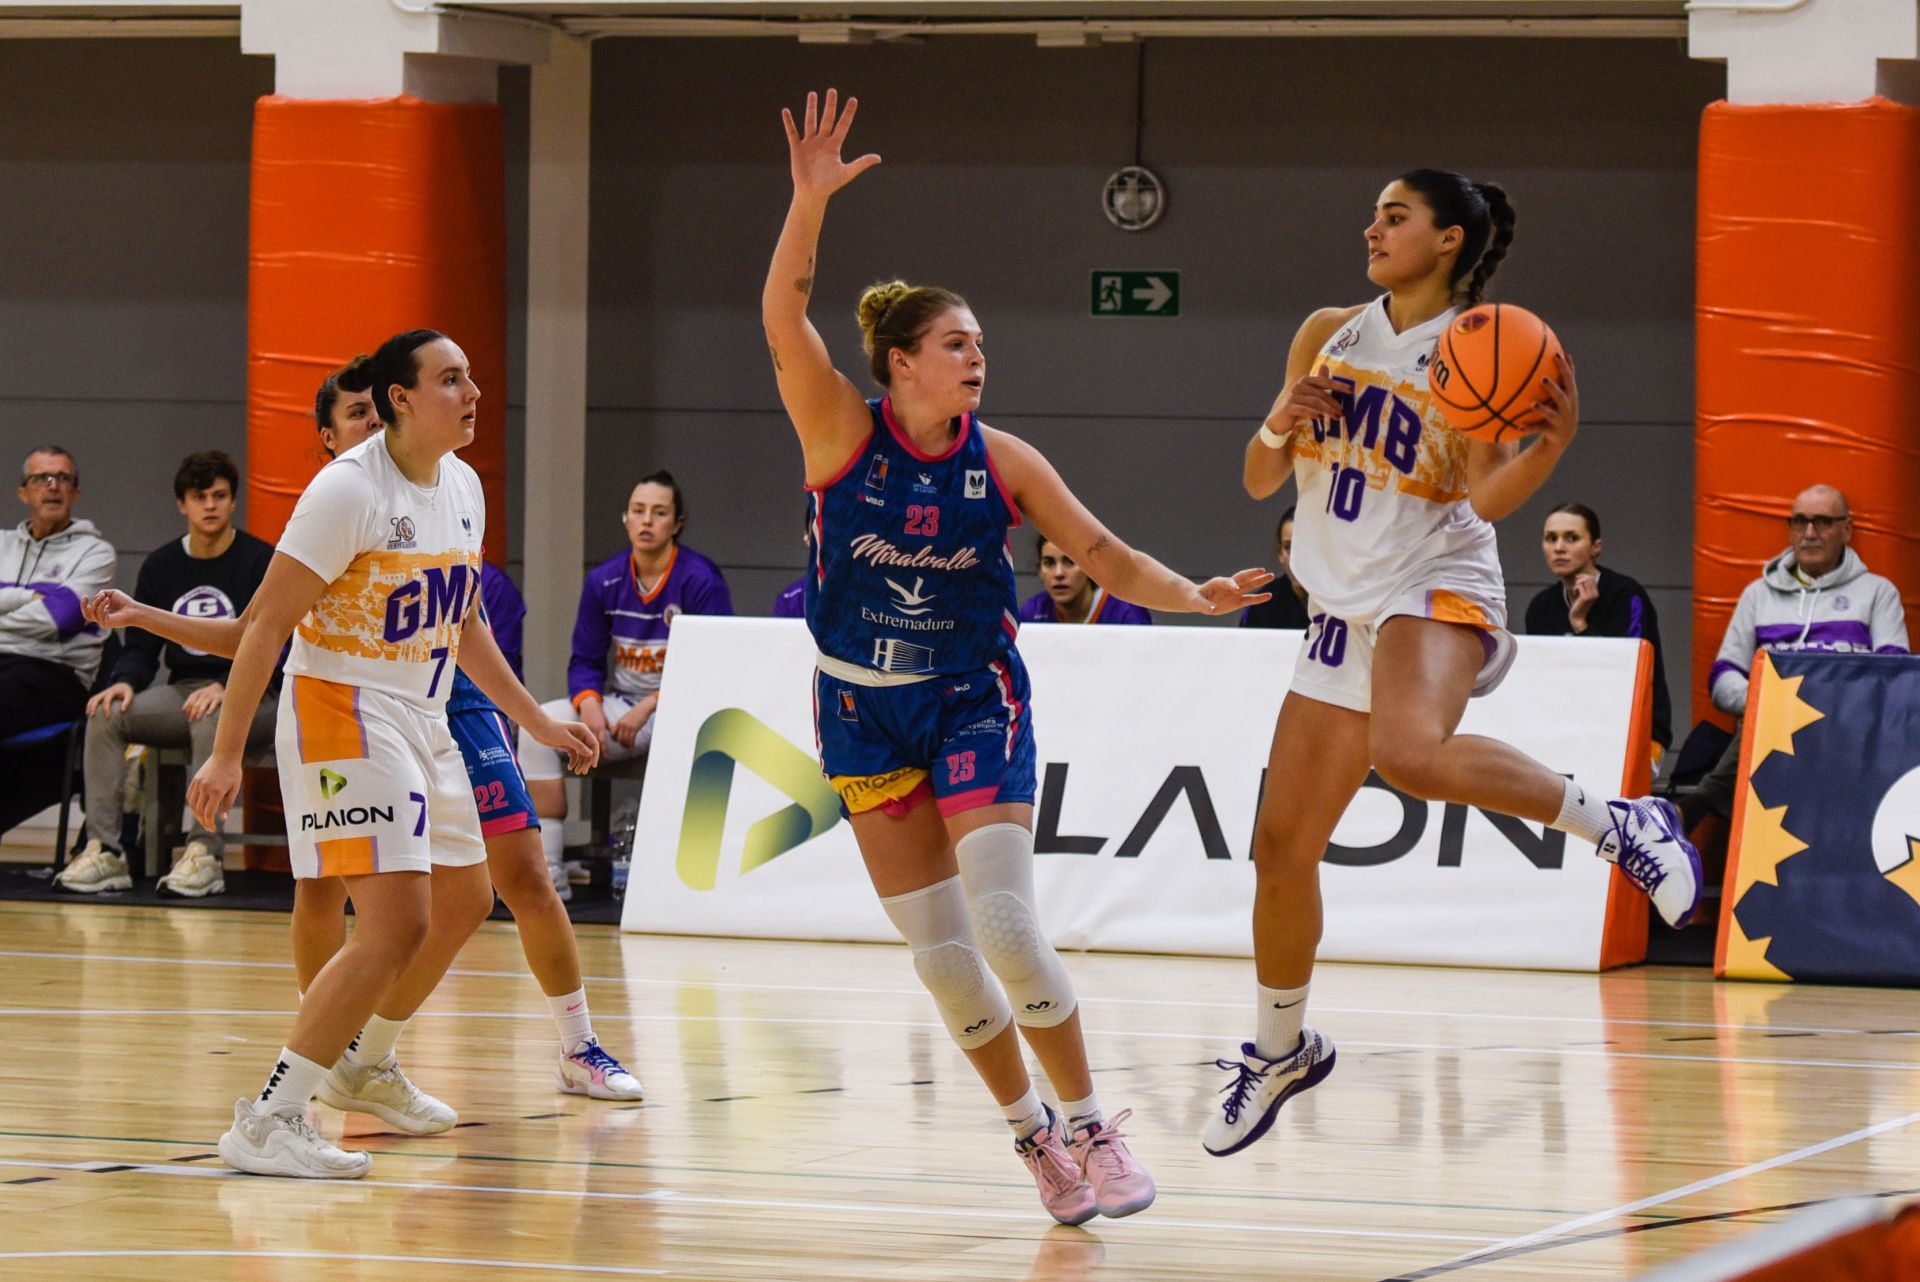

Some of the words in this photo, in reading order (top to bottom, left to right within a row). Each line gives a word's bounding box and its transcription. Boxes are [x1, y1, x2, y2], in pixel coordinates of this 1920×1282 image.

[1326, 462, 1367, 523] 10
[904, 504, 939, 536] 23
[850, 533, 981, 571] Miralvalle
[861, 606, 955, 631] Extremadura
[1307, 613, 1348, 669] 10
[426, 647, 449, 699] 7
[946, 751, 976, 786] 23
[409, 791, 426, 838] 7
[474, 780, 509, 813] 22
[301, 805, 395, 832] PLAION
